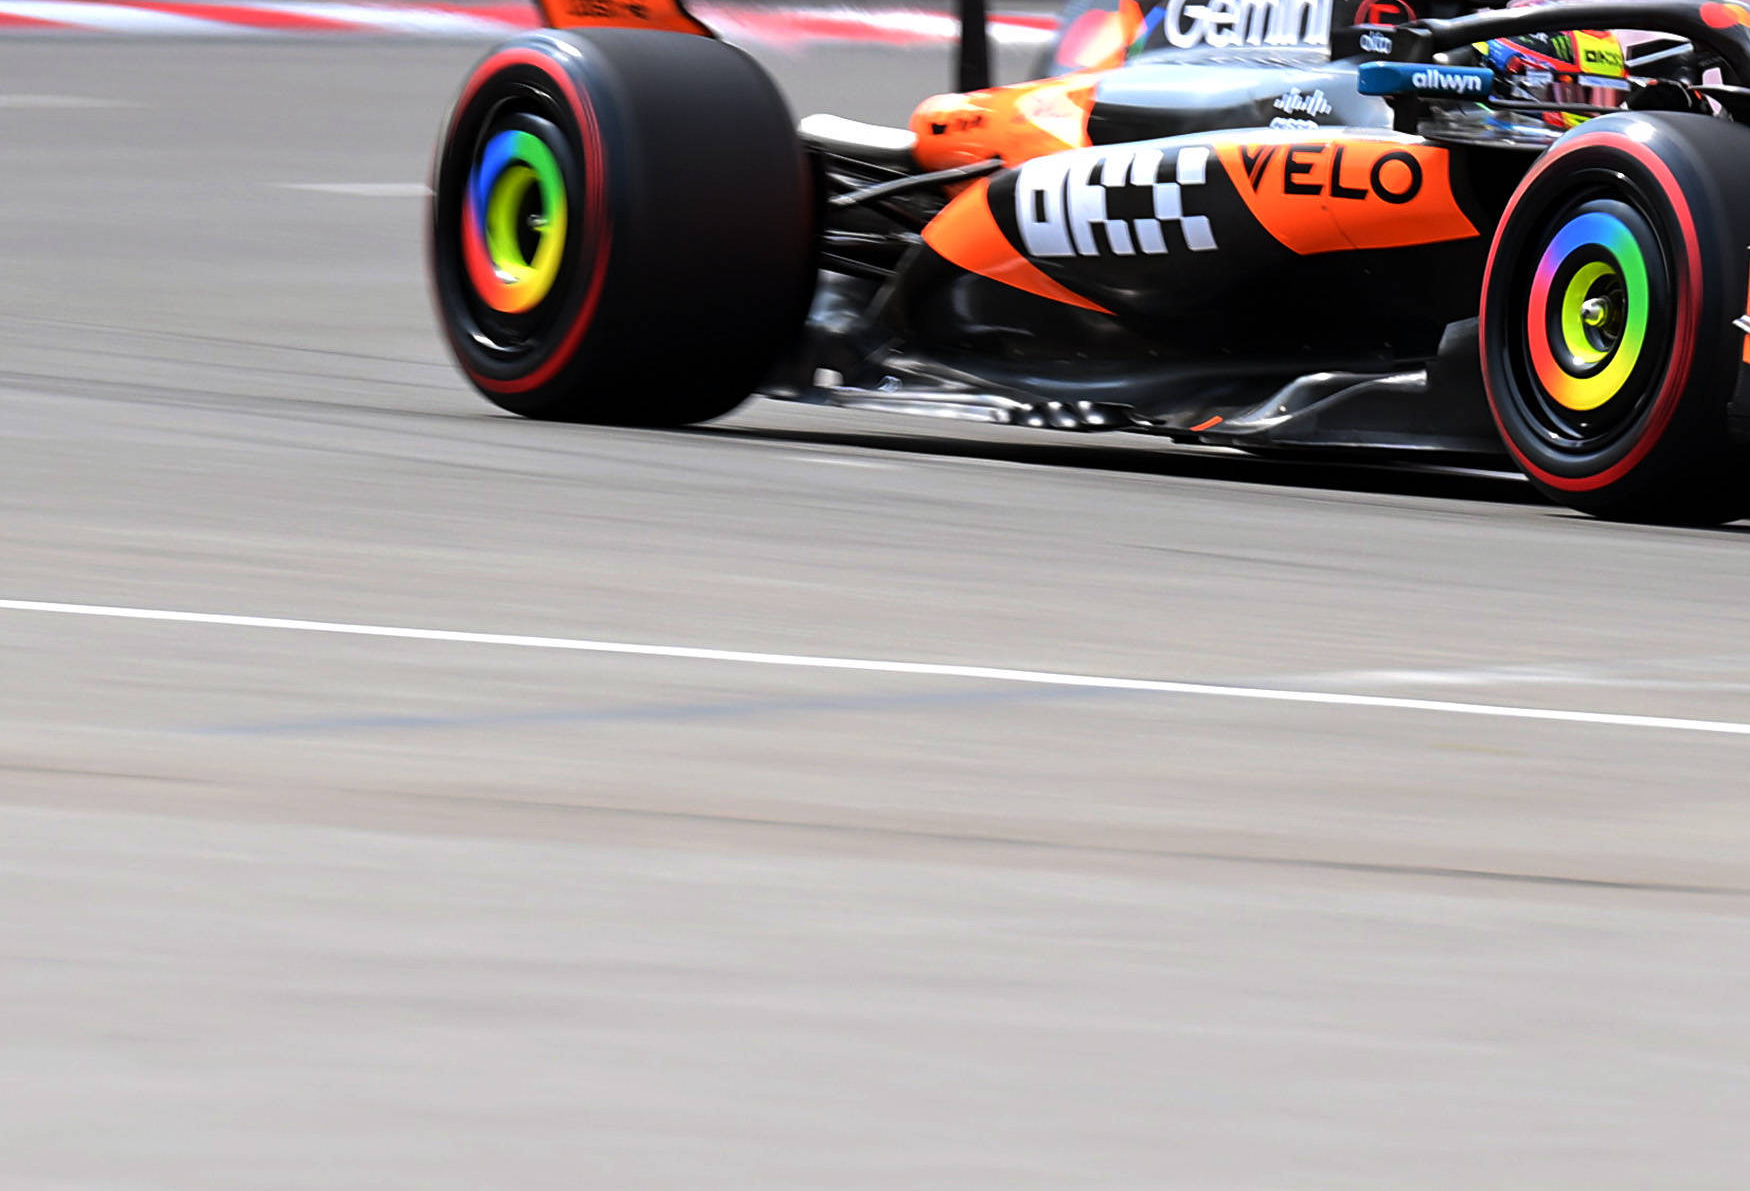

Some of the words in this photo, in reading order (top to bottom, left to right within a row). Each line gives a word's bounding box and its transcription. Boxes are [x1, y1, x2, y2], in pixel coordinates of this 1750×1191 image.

[1412, 69, 1482, 94] allwyn
[1015, 146, 1218, 257] OKX
[1240, 144, 1423, 205] VELO
